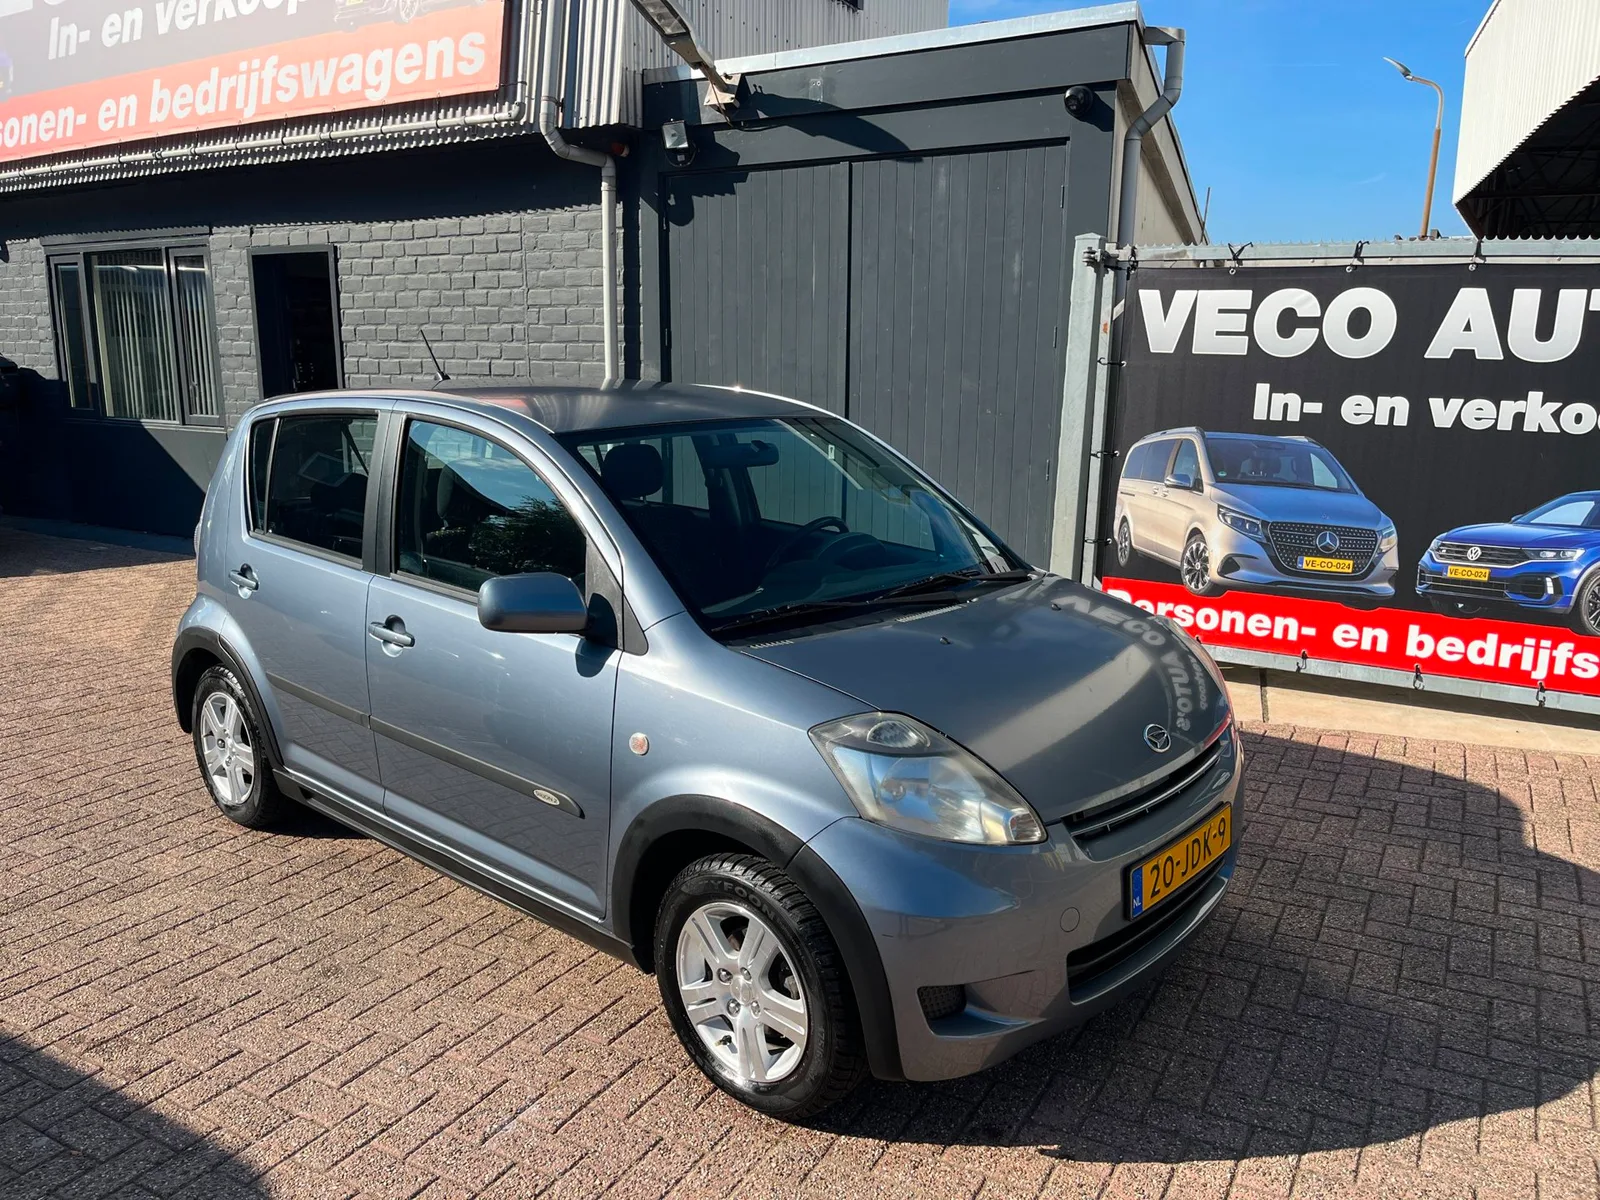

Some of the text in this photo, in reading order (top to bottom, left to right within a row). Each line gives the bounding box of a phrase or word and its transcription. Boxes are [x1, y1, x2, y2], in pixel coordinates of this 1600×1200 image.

[48, 17, 91, 60] In-
[101, 8, 143, 48] en
[0, 31, 486, 148] onen- en bedrijfswagens
[1138, 287, 1600, 363] VECO AU
[1253, 383, 1600, 435] In- en verko
[1305, 558, 1351, 571] VE-CO-024
[1449, 568, 1487, 578] VE-CO-024
[1332, 623, 1388, 653] en
[1406, 624, 1600, 680] bedrijfs
[1150, 817, 1226, 900] 20-JDK-9
[1133, 896, 1142, 909] NL
